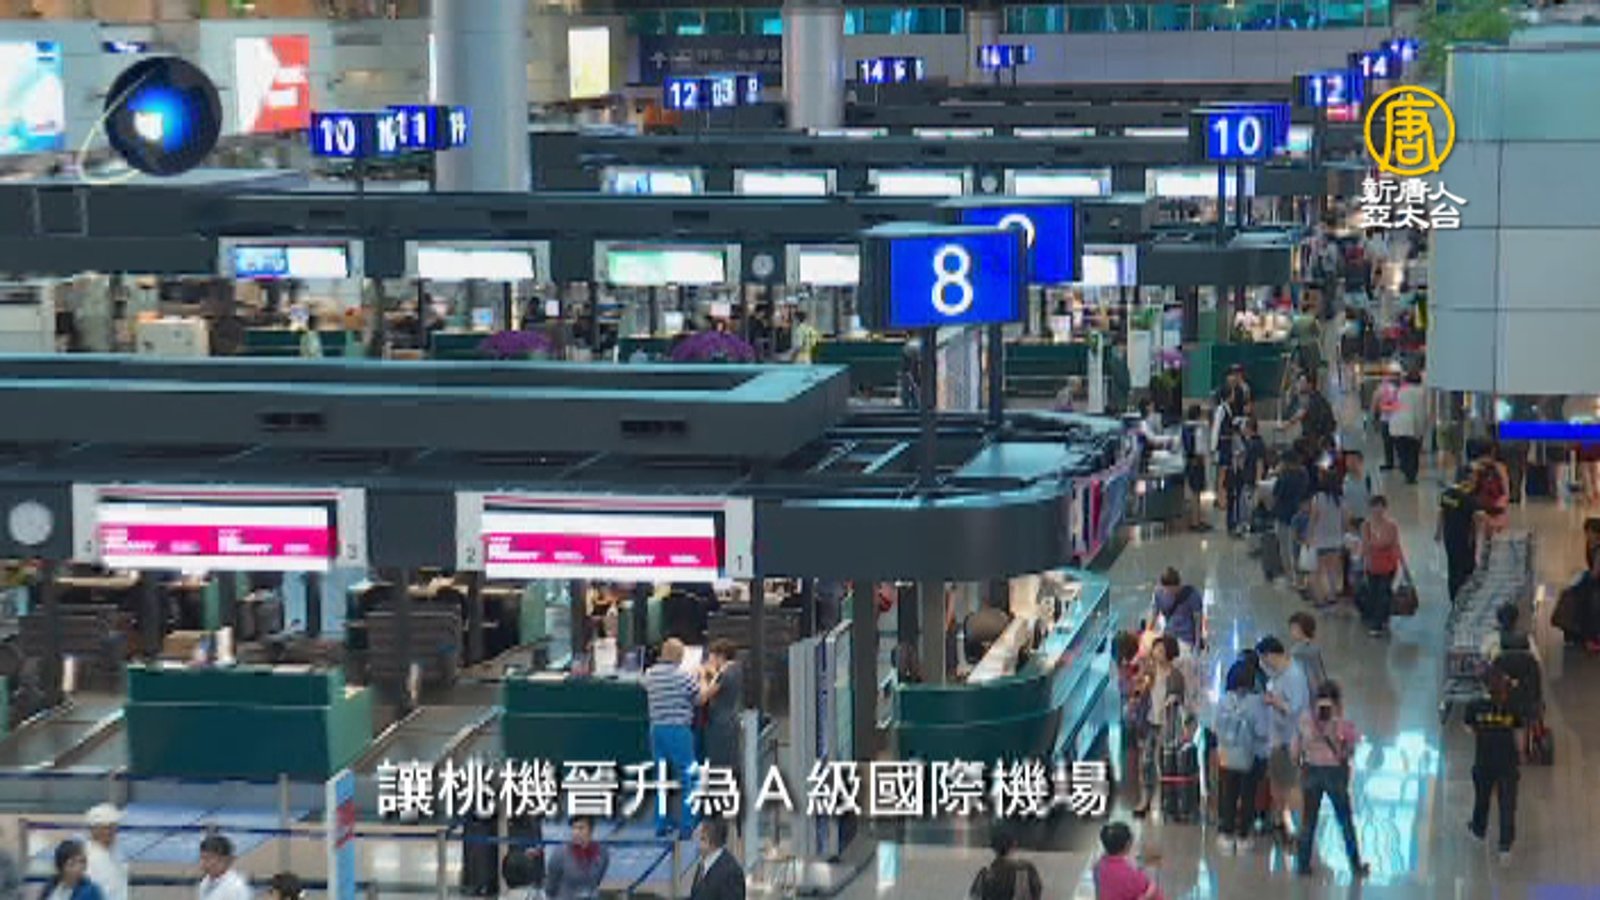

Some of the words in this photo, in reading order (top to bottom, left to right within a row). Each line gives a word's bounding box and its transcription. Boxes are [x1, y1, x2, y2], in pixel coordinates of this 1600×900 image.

[1360, 55, 1387, 77] 14
[671, 81, 698, 107] 12
[1309, 76, 1343, 105] 12
[320, 117, 356, 154] 10
[1213, 115, 1262, 155] 10
[931, 243, 974, 316] 8
